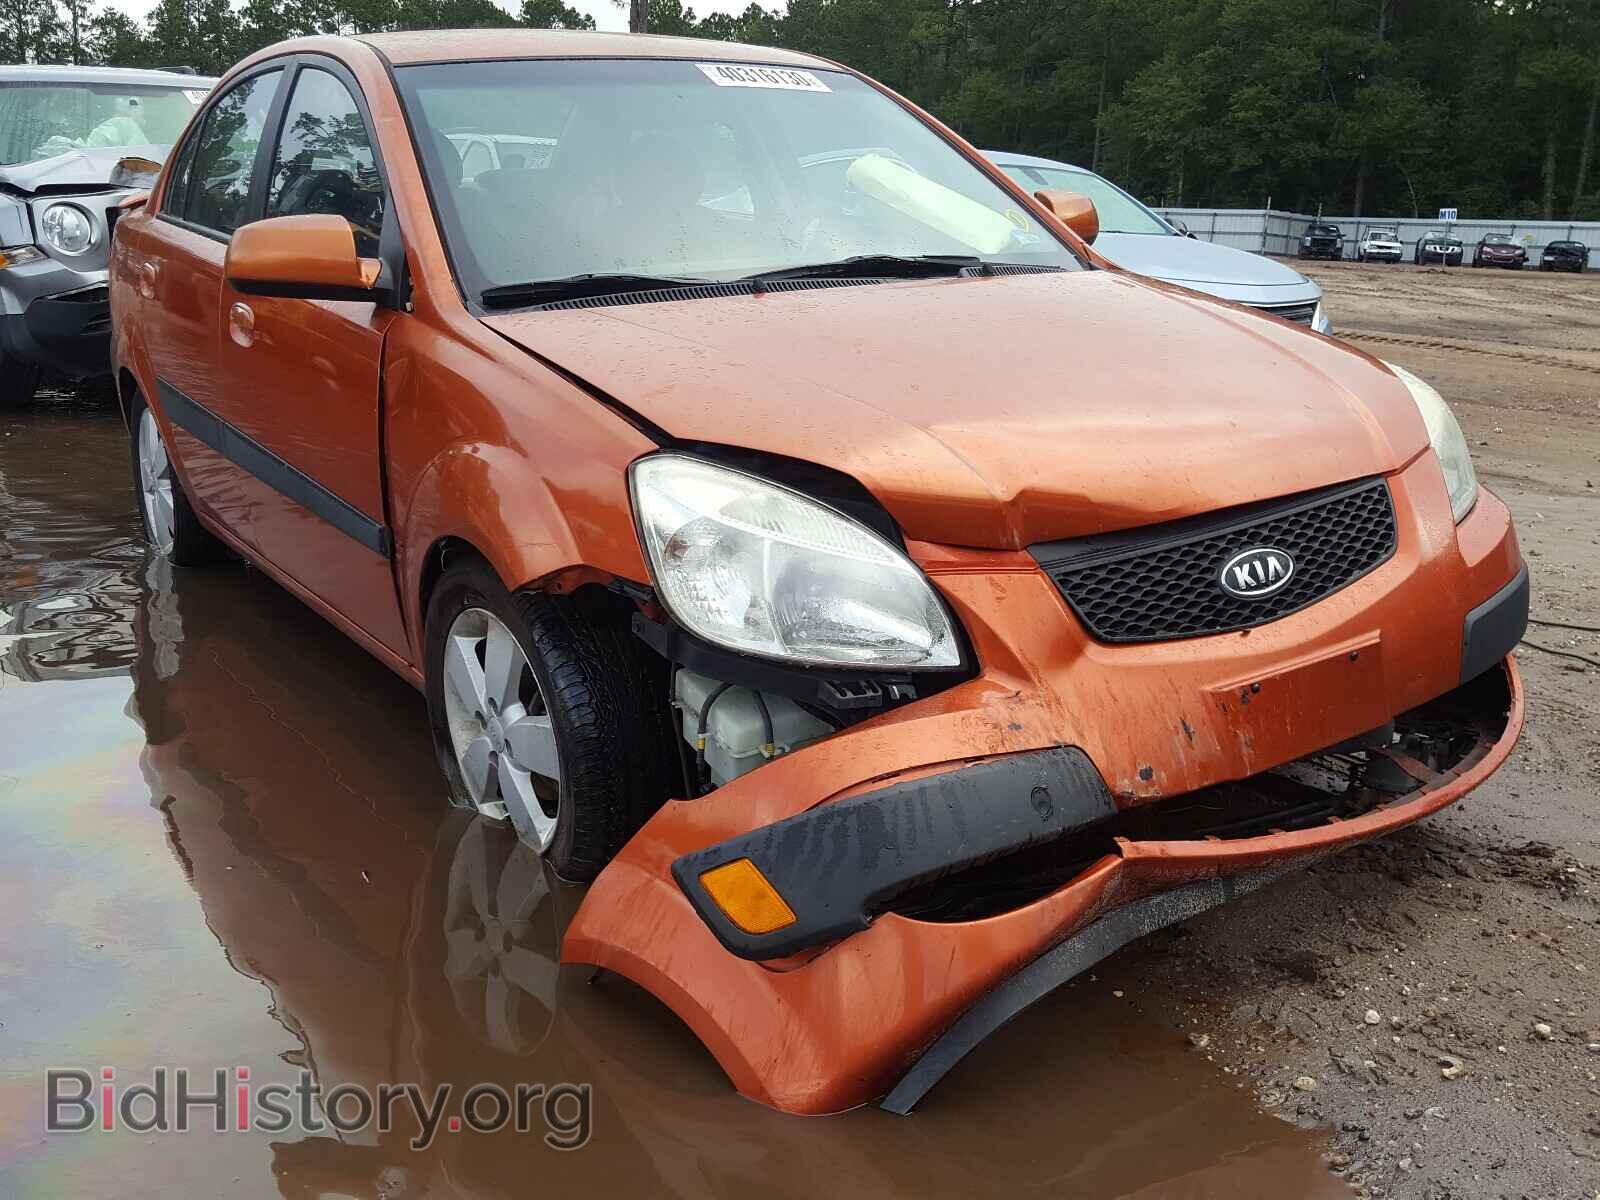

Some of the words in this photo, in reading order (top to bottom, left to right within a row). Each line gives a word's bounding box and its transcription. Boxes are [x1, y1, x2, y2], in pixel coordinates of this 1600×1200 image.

[716, 66, 811, 87] 40316130
[1440, 210, 1456, 220] M10
[1233, 556, 1287, 590] KIA
